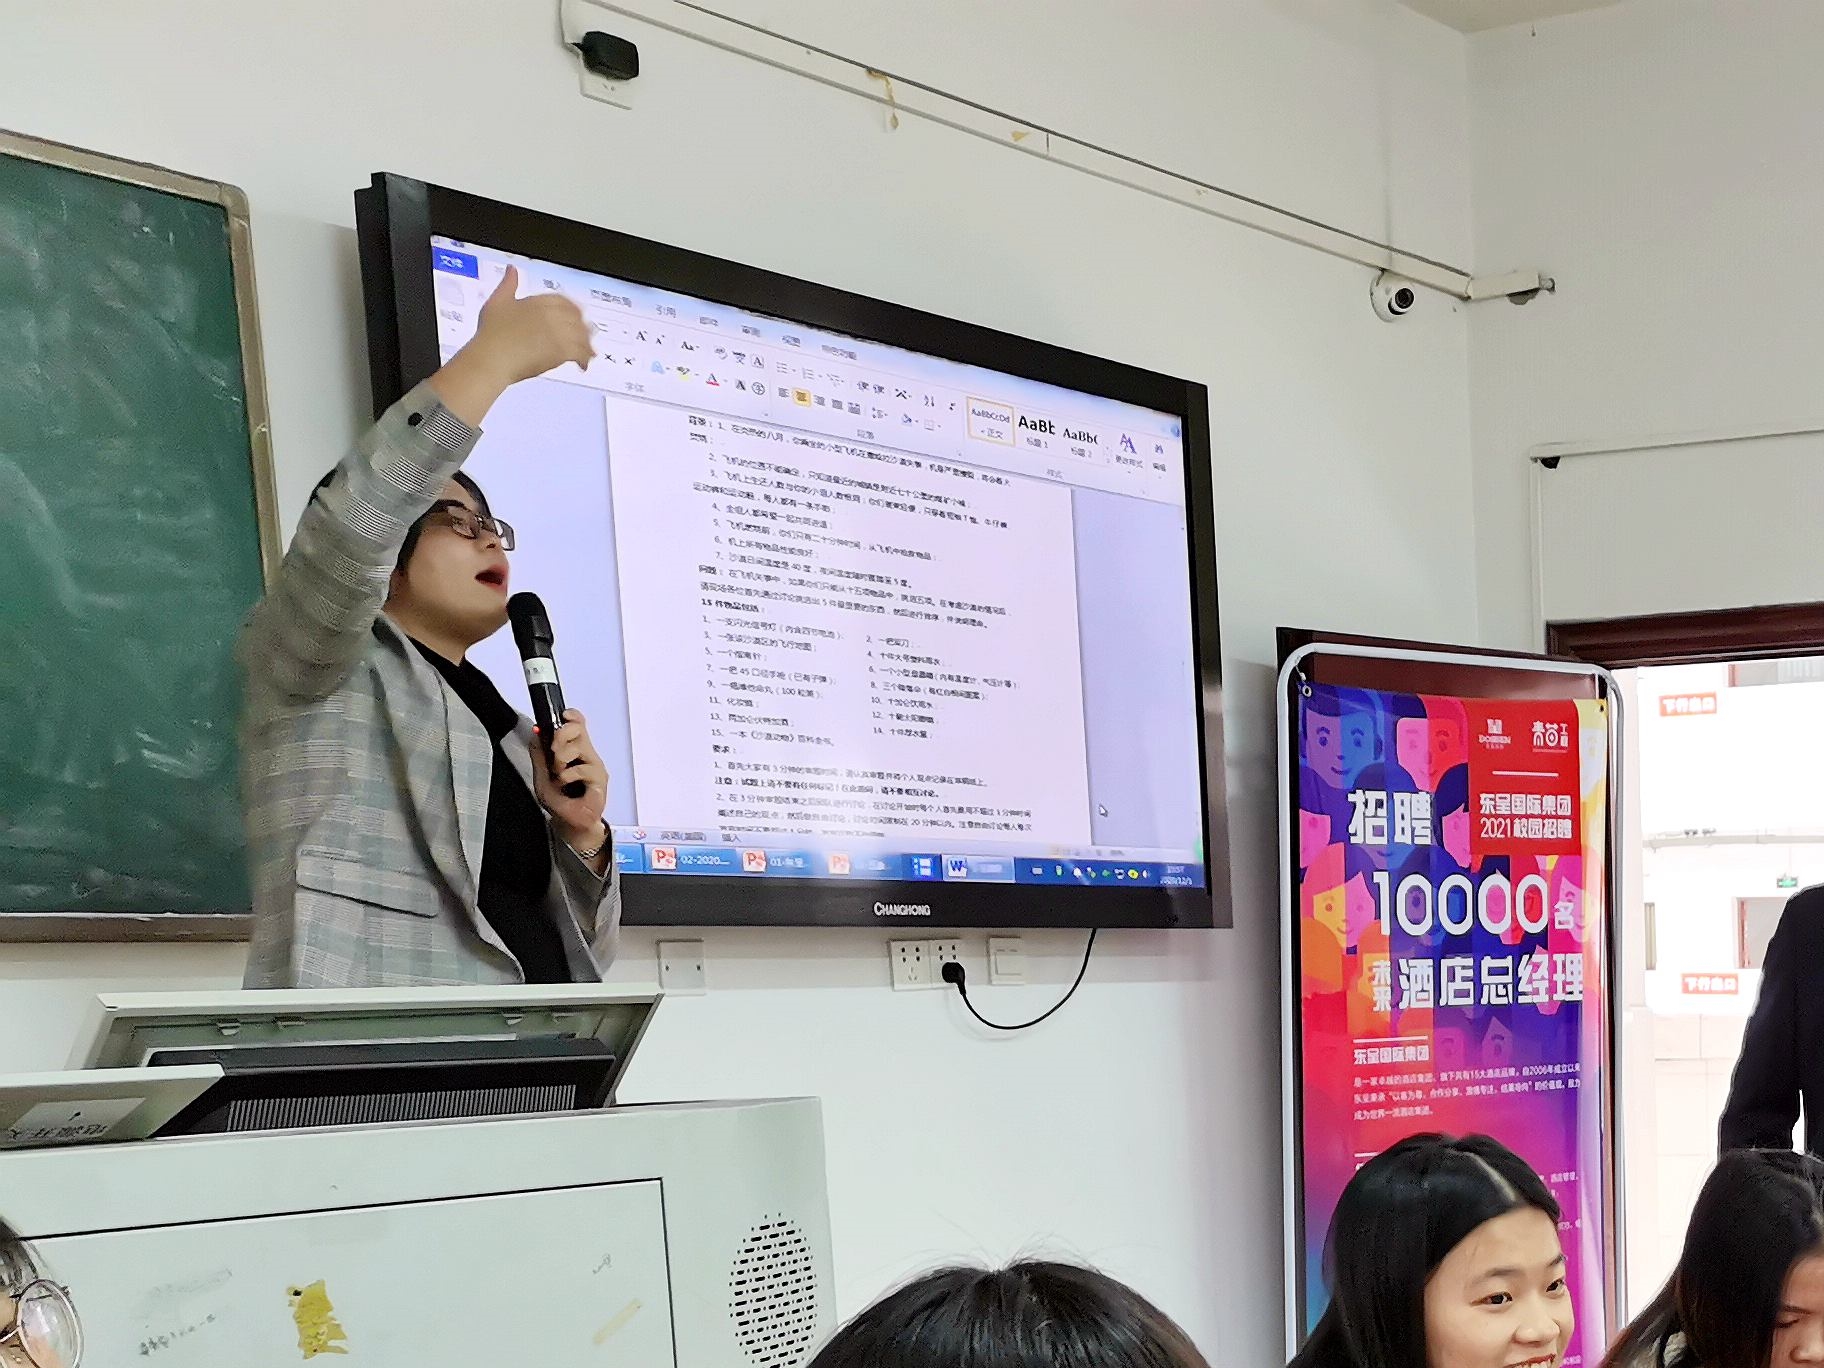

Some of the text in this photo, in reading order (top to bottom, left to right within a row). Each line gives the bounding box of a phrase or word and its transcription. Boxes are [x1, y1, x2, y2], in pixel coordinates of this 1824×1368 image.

[1479, 793, 1572, 816] 东呈国际集团
[1347, 788, 1433, 845] 招聘
[873, 902, 931, 917] CHANGHONG
[1398, 952, 1584, 1010] 酒店总经理
[1353, 1045, 1430, 1065] 东呈国际集团
